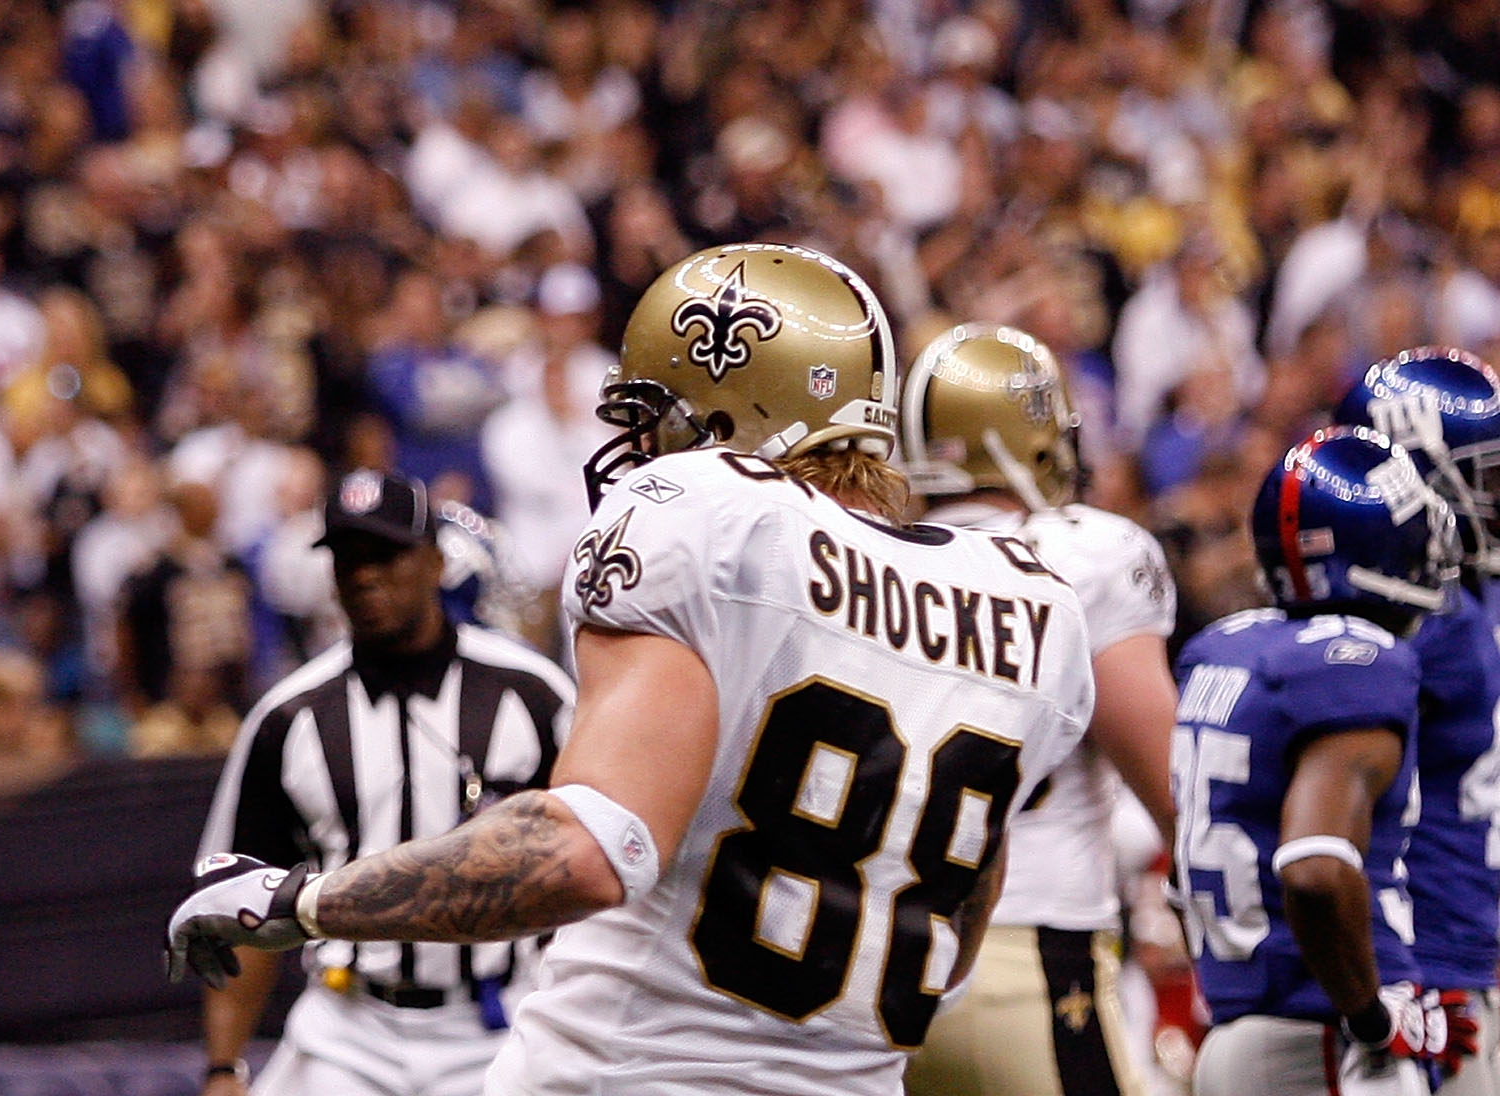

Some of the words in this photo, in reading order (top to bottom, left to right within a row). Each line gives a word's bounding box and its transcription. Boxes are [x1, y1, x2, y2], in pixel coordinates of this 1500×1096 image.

[811, 379, 833, 394] NFL
[808, 530, 1052, 689] SHOCKEY
[687, 674, 1024, 1052] 88
